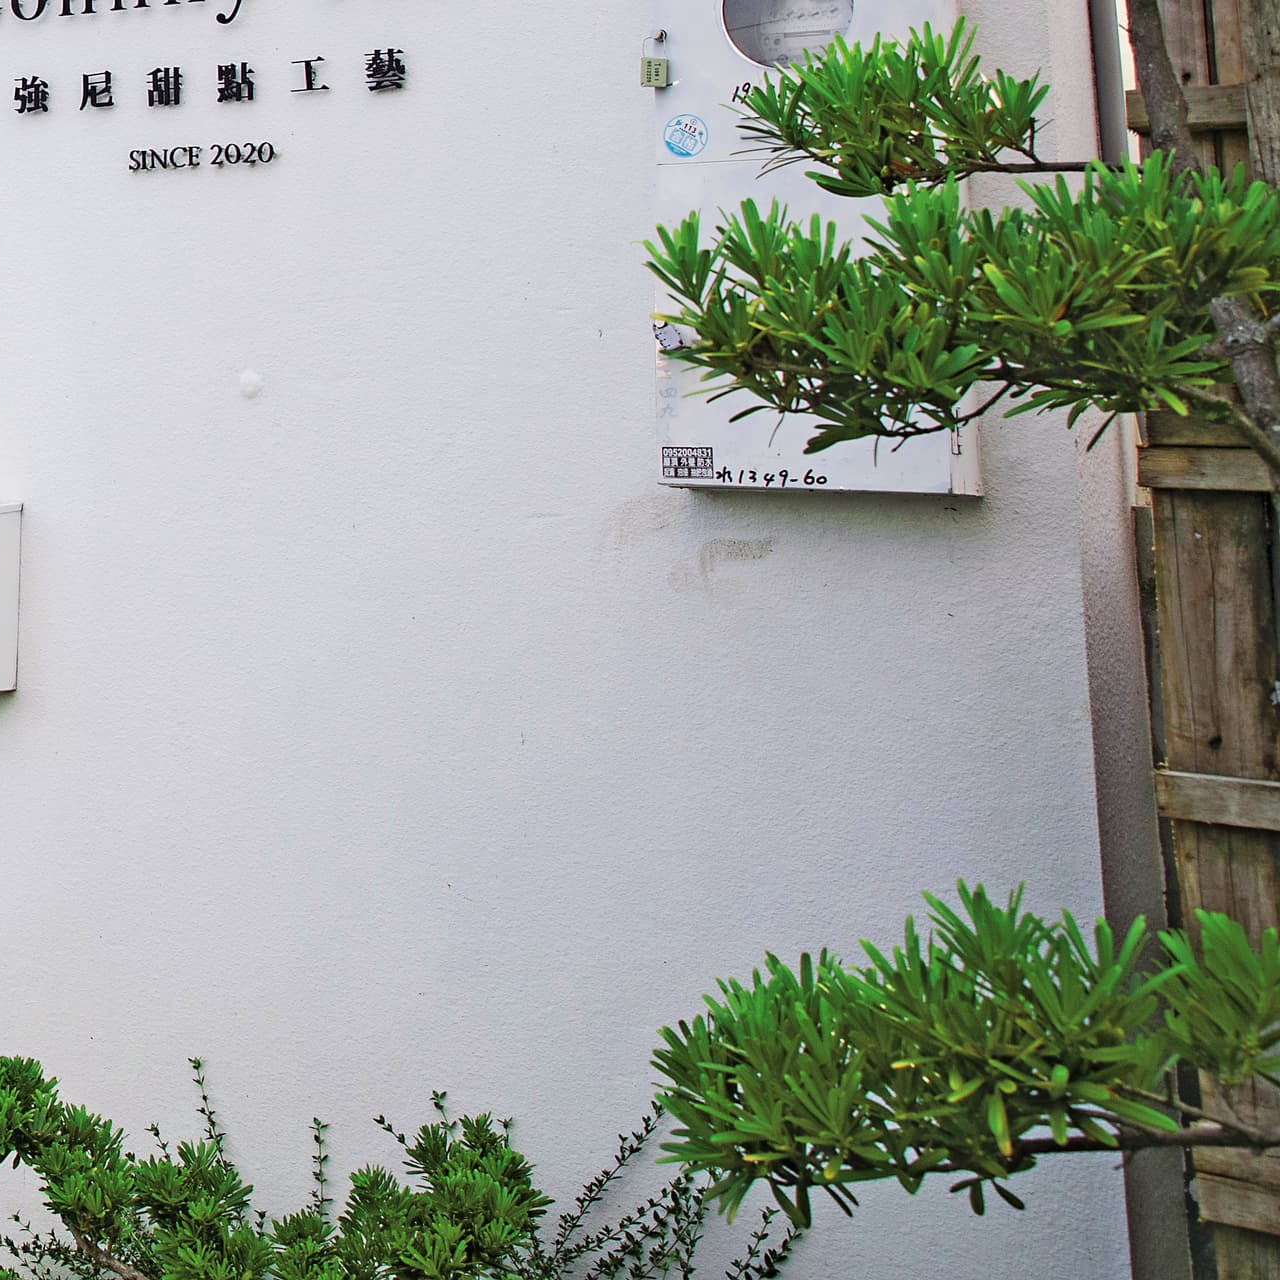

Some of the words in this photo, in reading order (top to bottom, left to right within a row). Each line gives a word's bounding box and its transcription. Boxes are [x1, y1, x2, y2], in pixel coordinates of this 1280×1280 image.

[13, 48, 406, 114] 強尼甜點工藝
[128, 146, 202, 172] SINCE
[210, 141, 276, 167] 2020
[663, 448, 711, 458] 0952004831
